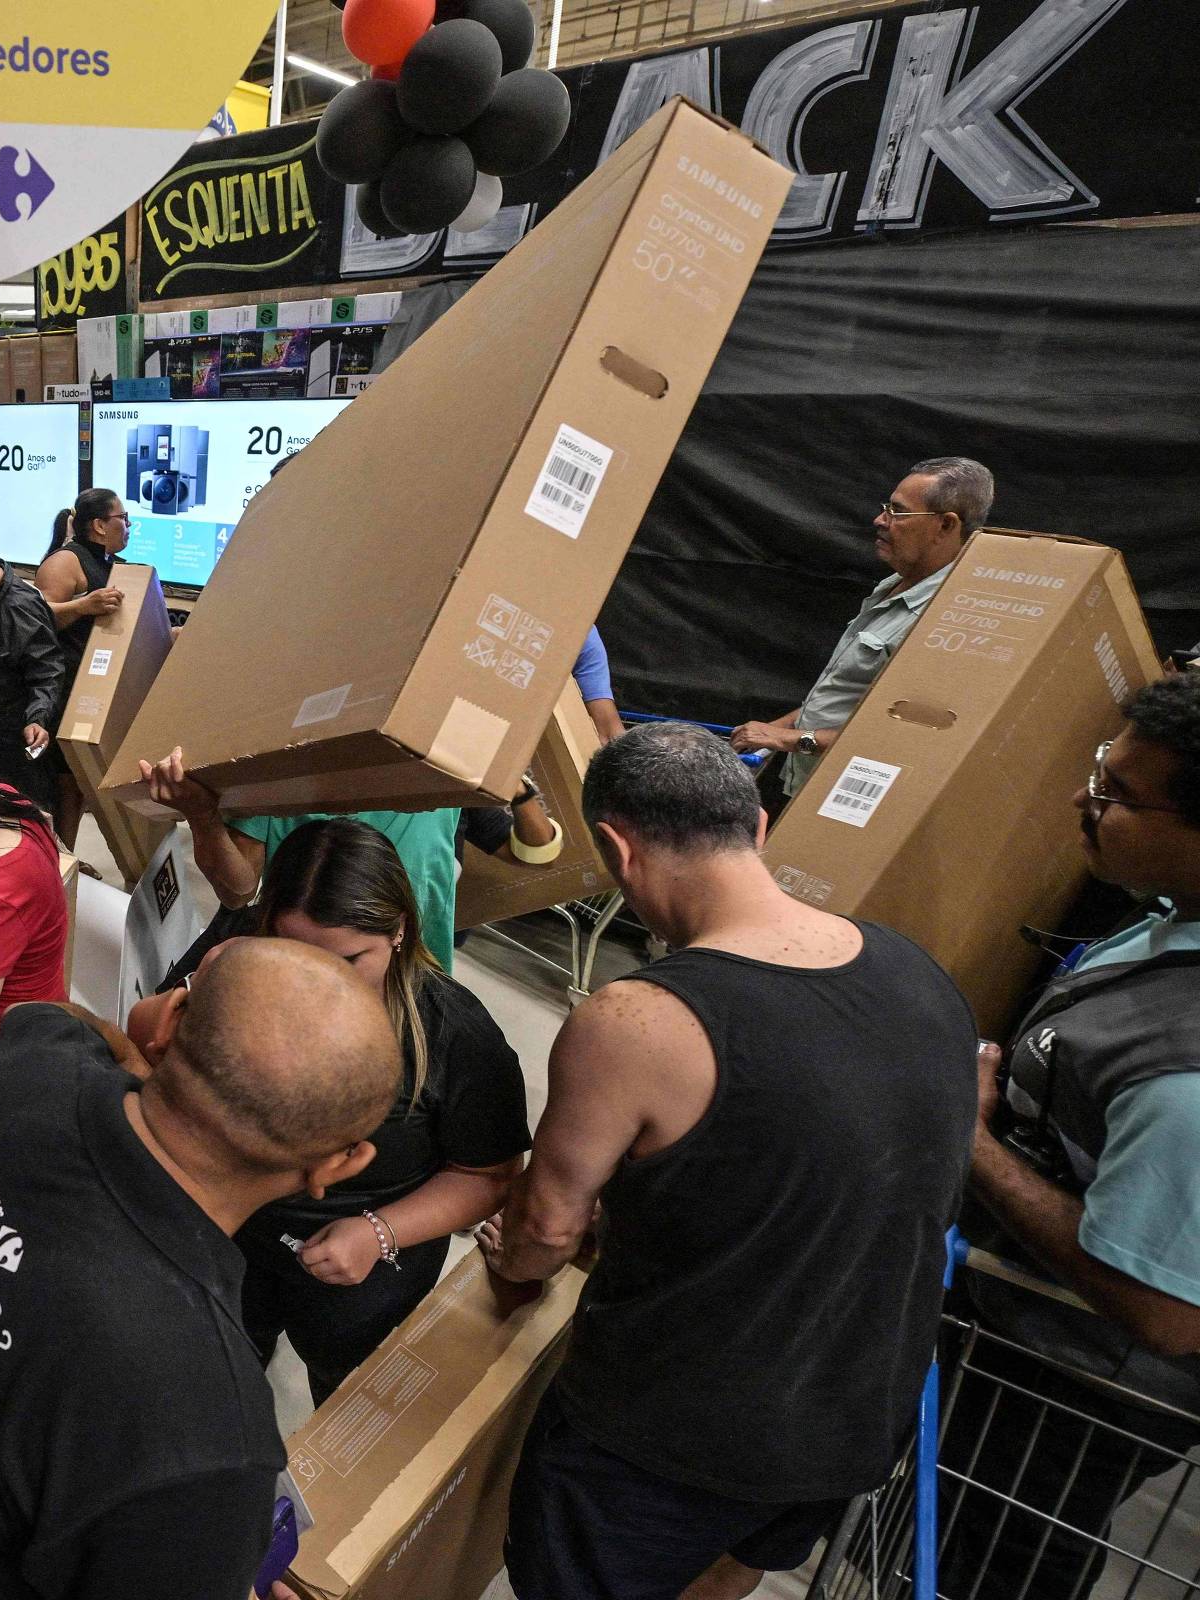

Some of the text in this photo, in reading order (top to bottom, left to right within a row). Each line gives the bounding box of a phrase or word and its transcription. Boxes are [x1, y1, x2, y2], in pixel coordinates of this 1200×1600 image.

[676, 155, 764, 219] SAMSUNG
[146, 161, 319, 266] ESQUENTA
[660, 193, 745, 253] Crystal UHD
[648, 215, 705, 259] DU7700
[99, 410, 139, 420] SAMSUNG
[27, 454, 45, 462] Anos
[46, 454, 57, 463] de
[247, 426, 283, 455] 20
[972, 565, 1066, 589] SAMSUNG
[940, 610, 1000, 630] DU7700
[954, 594, 1045, 617] Crystal UHD
[1094, 631, 1129, 704] SAMSUNG
[386, 1466, 468, 1572] SAMSUNG
